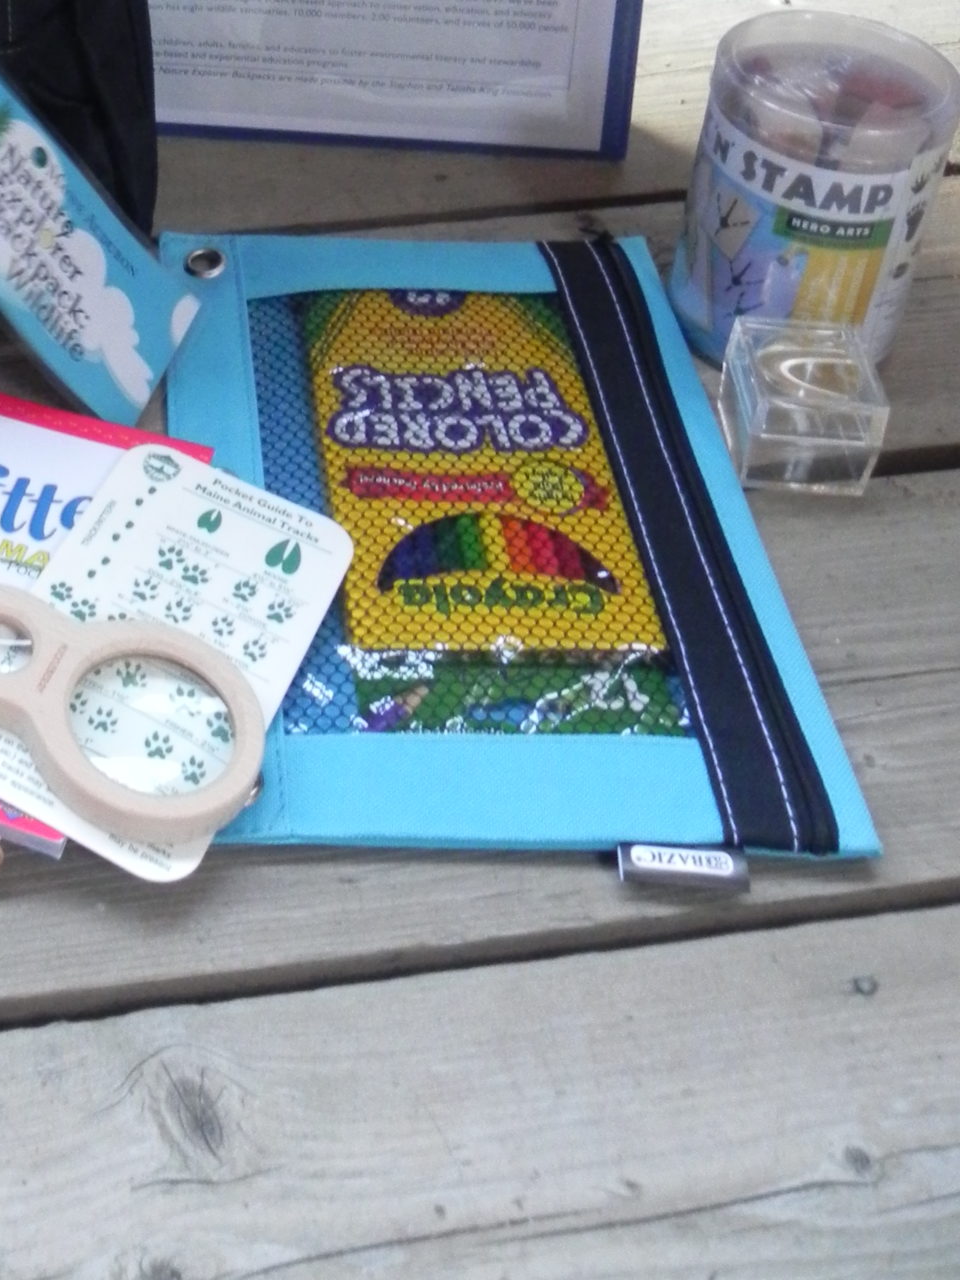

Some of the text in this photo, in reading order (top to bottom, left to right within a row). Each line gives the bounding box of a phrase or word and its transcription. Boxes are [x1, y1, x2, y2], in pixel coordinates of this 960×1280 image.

[1, 144, 75, 238] Nature
[741, 150, 894, 215] STAMP
[791, 217, 870, 236] HERO ARTS
[6, 259, 85, 362] Wildlife
[341, 366, 562, 412] PENCILS
[334, 409, 584, 450] COLORED
[195, 483, 320, 544] Maine Animal Tracks
[212, 477, 313, 528] Pocket Guide To
[399, 576, 605, 616] Crayola
